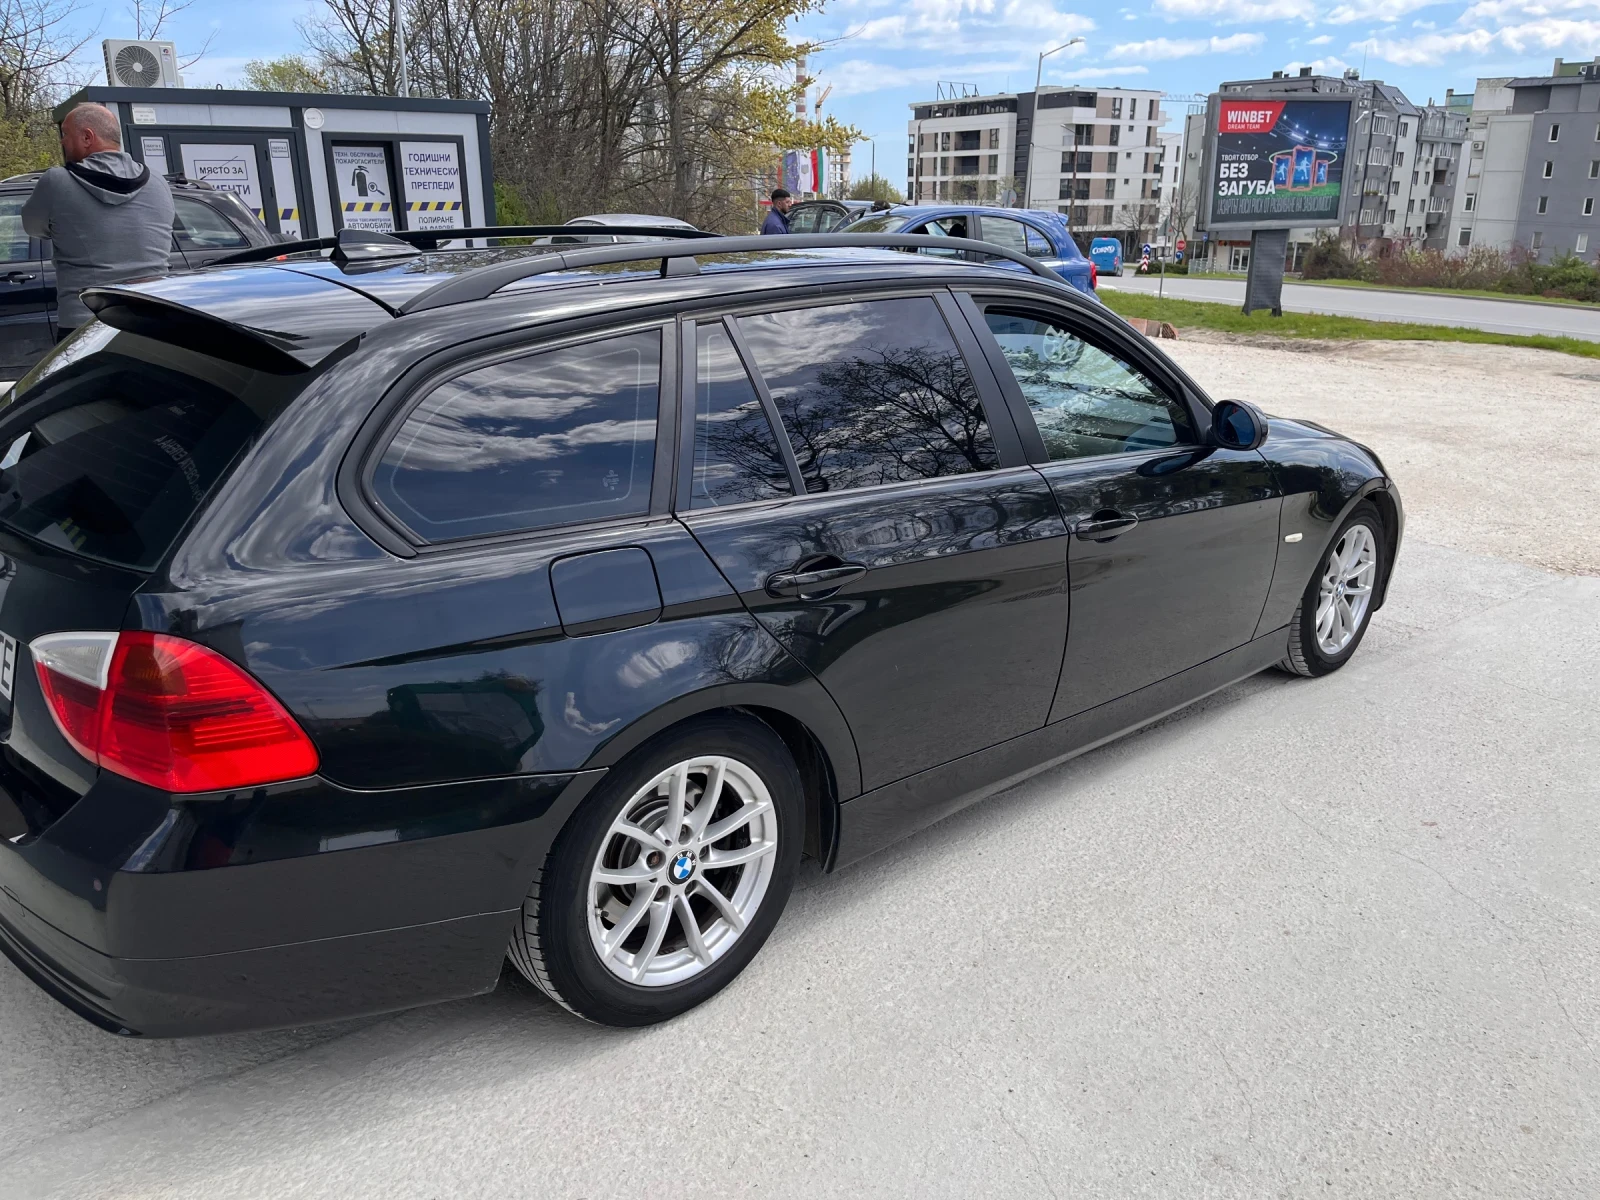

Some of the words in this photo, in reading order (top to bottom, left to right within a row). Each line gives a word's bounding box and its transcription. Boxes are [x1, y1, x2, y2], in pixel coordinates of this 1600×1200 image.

[1227, 111, 1273, 123] WINBET
[408, 153, 451, 163] ГОДИШНИ
[404, 167, 459, 176] ТЕХНИЧЕСКИ
[1219, 163, 1249, 178] БЕЗ
[411, 181, 455, 191] ПРЕГЛЕДИ
[1218, 180, 1276, 196] ЗАГУБА
[418, 216, 454, 224] ПОЛИРАНЕ
